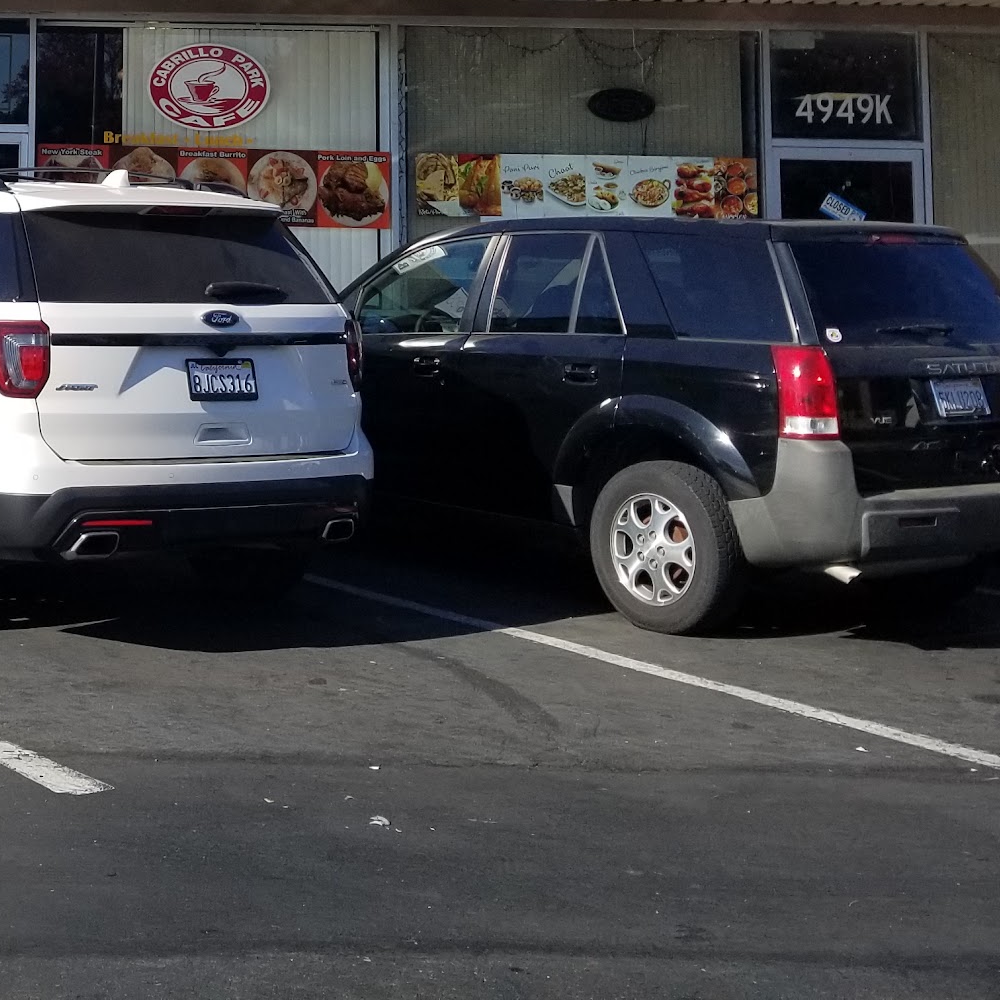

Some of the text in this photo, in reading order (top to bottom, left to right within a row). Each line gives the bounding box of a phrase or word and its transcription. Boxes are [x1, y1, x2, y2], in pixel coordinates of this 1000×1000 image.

[152, 47, 265, 88] CABRILLO PARK
[159, 98, 261, 127] CAFE
[795, 93, 893, 125] 4949K
[103, 131, 179, 145] Breakfast
[79, 148, 103, 156] Steak
[179, 150, 247, 159] Breakfast Burrito
[368, 155, 387, 163] Eggs
[548, 162, 574, 179] Chaat
[826, 196, 851, 216] CLOSED
[211, 312, 233, 324] Ford
